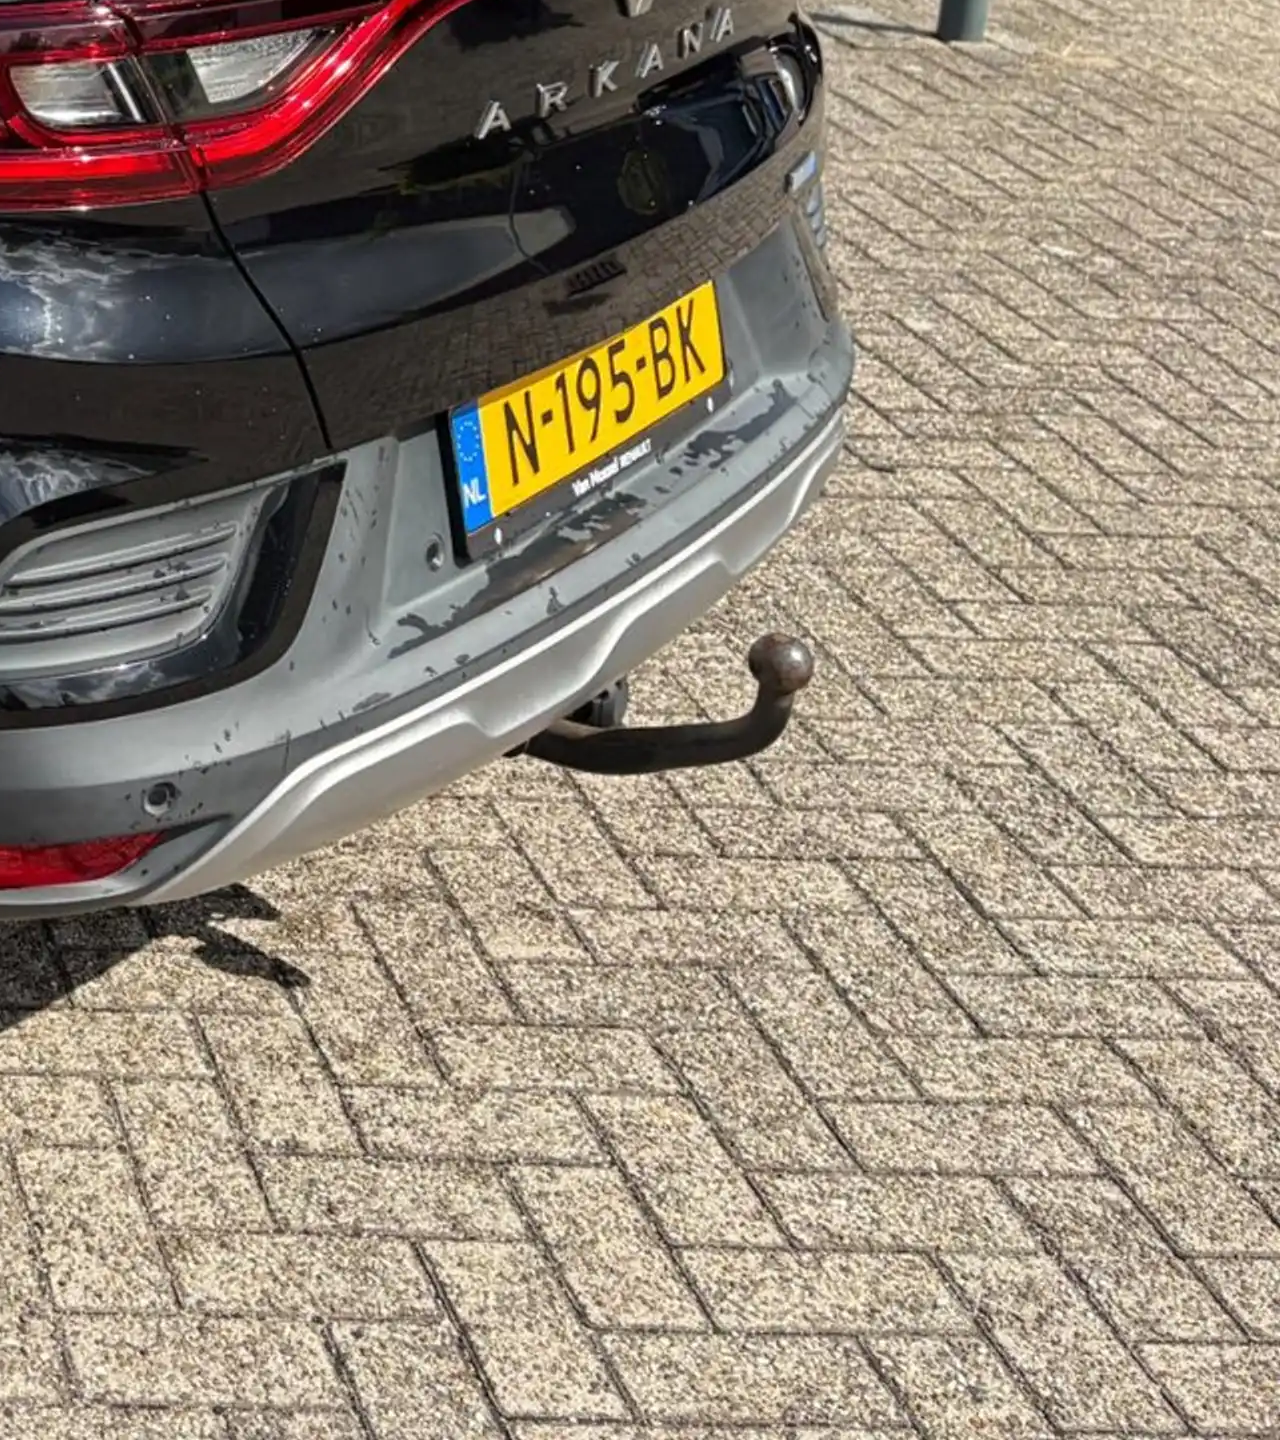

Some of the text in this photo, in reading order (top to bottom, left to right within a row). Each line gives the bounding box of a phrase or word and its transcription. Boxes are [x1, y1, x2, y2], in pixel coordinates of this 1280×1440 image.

[474, 7, 735, 140] ARKANA
[503, 298, 707, 488] N-195-BK
[463, 476, 487, 509] NL
